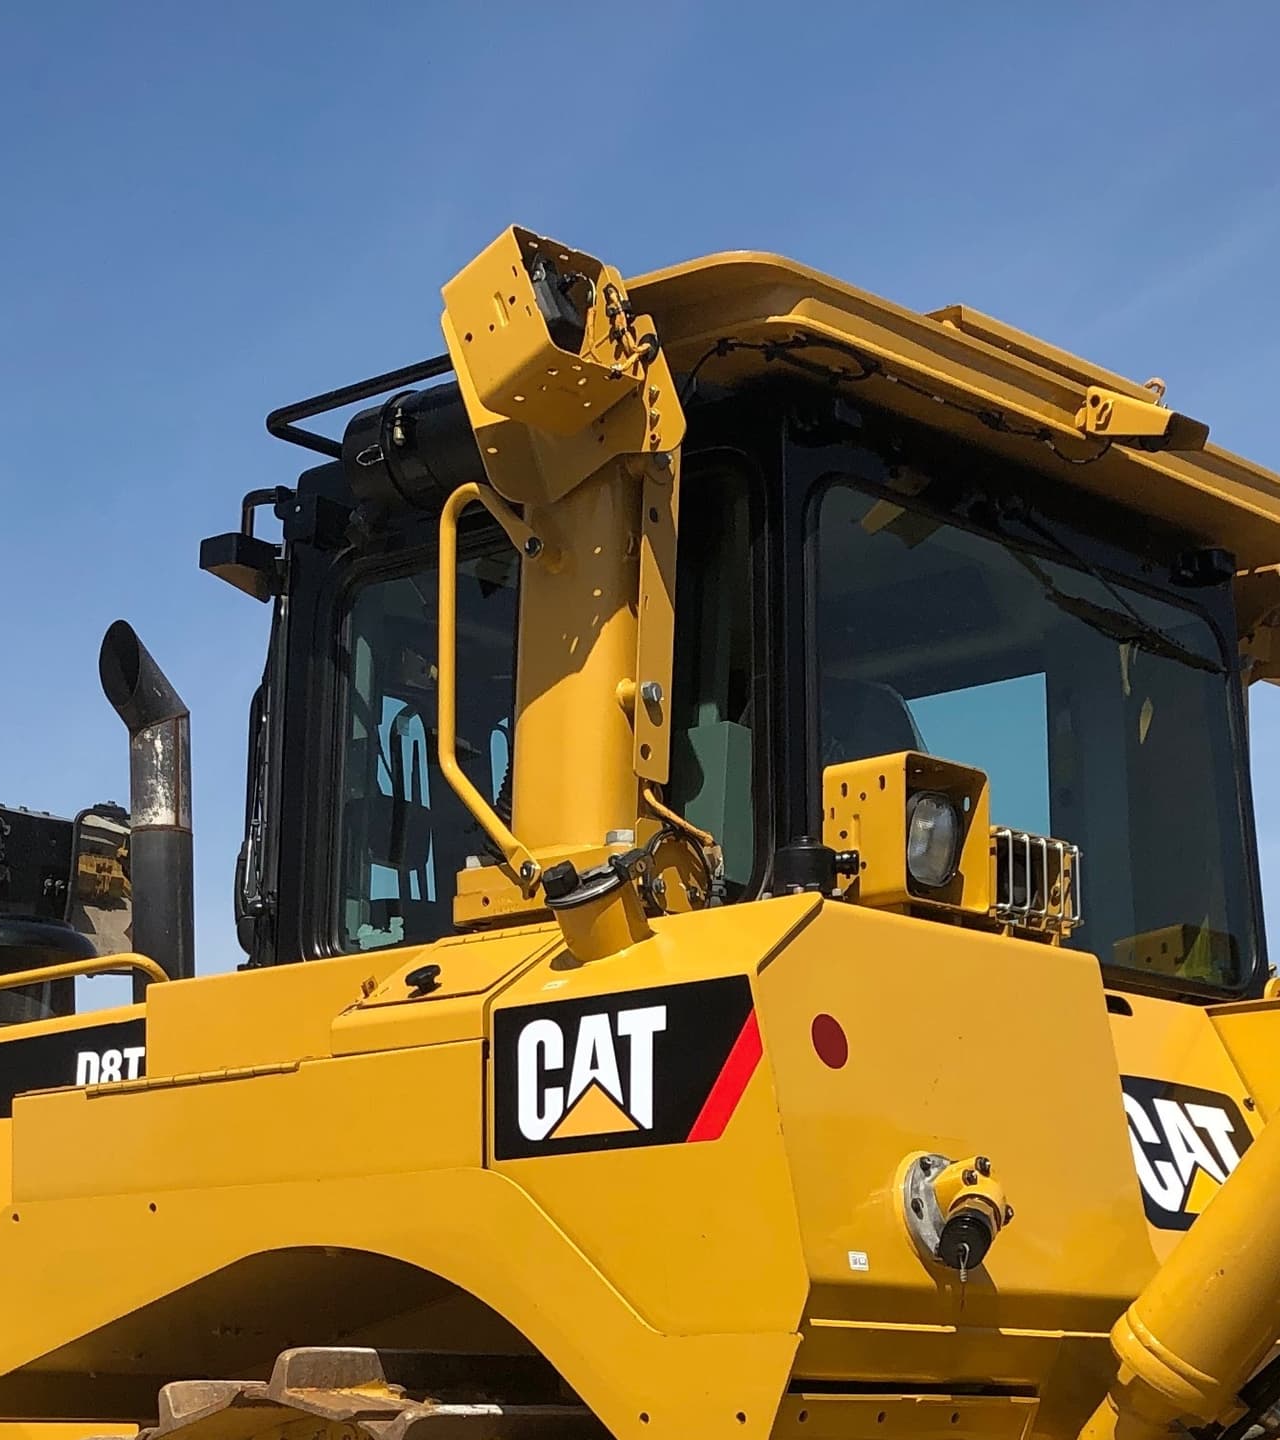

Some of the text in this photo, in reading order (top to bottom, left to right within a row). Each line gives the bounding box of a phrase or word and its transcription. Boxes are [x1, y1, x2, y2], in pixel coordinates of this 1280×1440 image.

[76, 1047, 145, 1086] D8T
[518, 1005, 667, 1141] CAT
[1122, 1092, 1241, 1212] CAT
